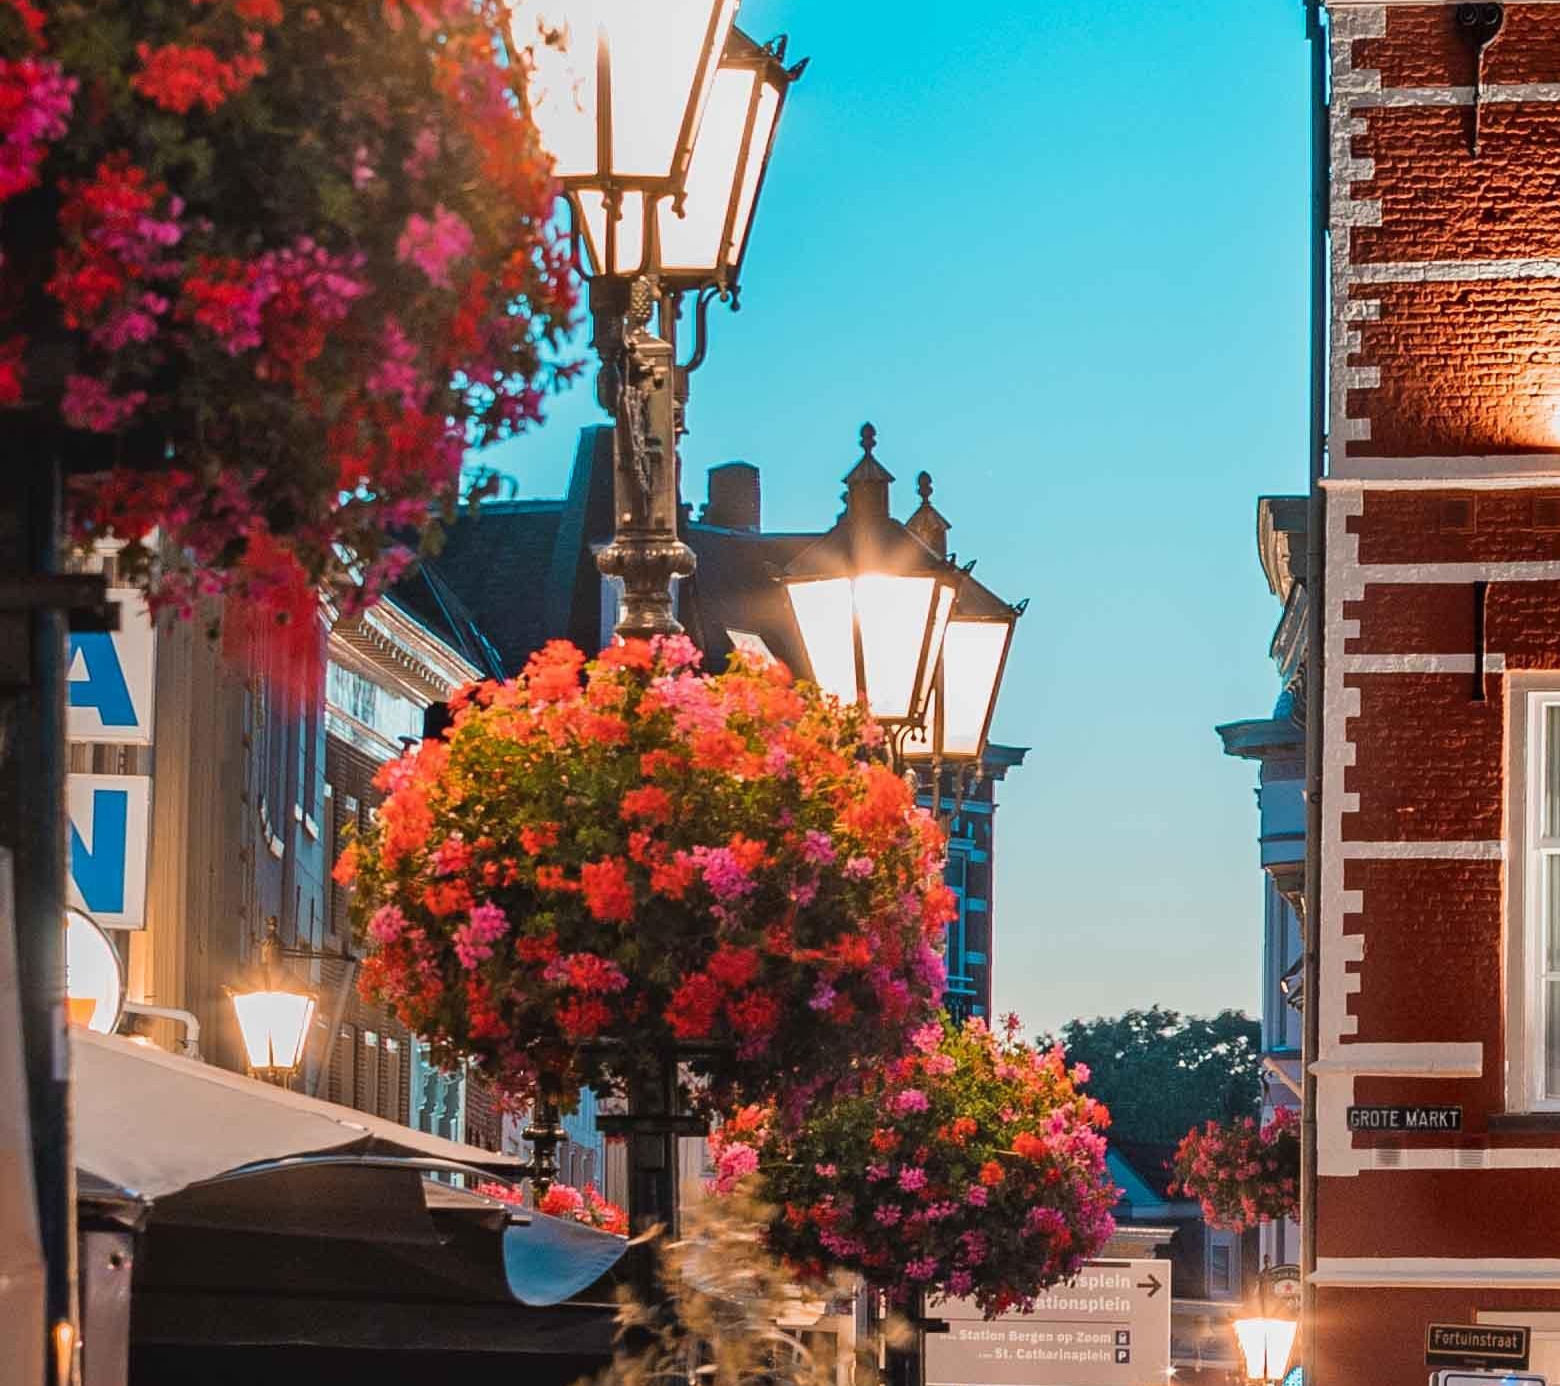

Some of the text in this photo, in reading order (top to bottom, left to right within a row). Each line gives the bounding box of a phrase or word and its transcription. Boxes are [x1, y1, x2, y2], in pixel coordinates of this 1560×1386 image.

[1350, 1110, 1459, 1128] GROTE MARKT
[1033, 1295, 1131, 1313] ationsplein
[960, 1329, 1005, 1342] Station
[1008, 1330, 1053, 1345] Bergen
[1057, 1332, 1073, 1345] op
[1076, 1332, 1112, 1343] Zoom
[1435, 1329, 1518, 1349] Fortuinstraat
